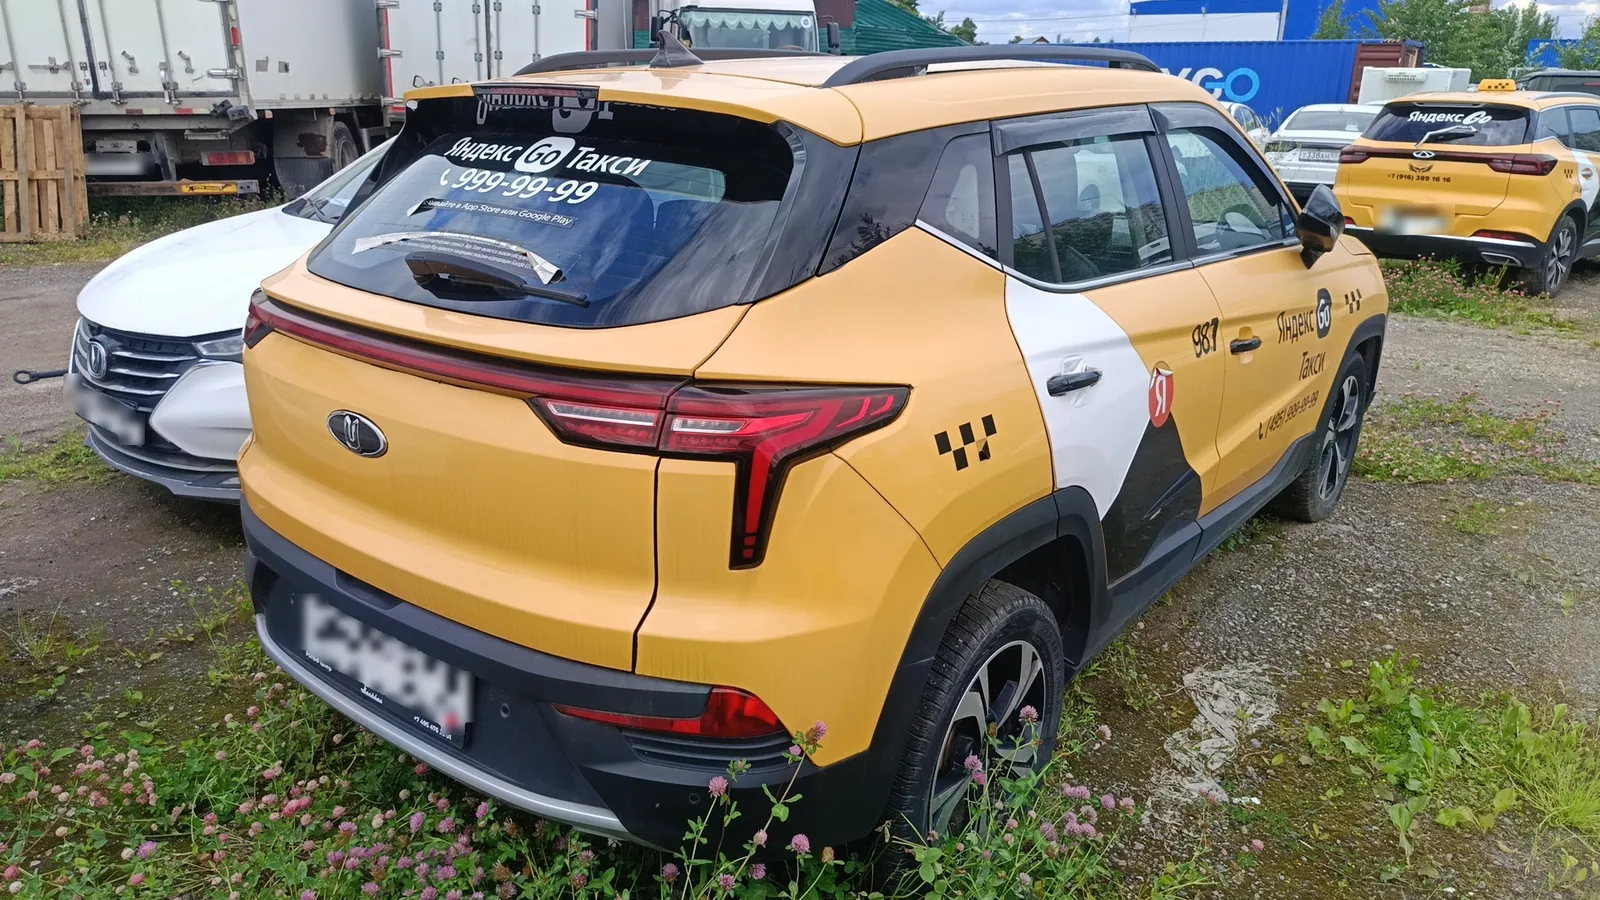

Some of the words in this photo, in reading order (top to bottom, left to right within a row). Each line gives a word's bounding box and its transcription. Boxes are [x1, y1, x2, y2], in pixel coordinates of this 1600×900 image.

[1407, 111, 1464, 123] Яндекс
[1463, 111, 1493, 124] Go
[444, 137, 524, 162] Яндекс
[566, 146, 651, 176] Такси
[452, 168, 599, 204] 999-99-99
[461, 202, 478, 212] App
[477, 204, 501, 214] Store
[500, 208, 518, 216] или
[518, 210, 551, 222] Google
[551, 214, 573, 226] Play
[1276, 310, 1315, 344] Яндекс
[1316, 296, 1331, 331] Go
[1298, 351, 1327, 381] Такси
[1154, 374, 1167, 418] Я
[1264, 408, 1287, 438] (495)
